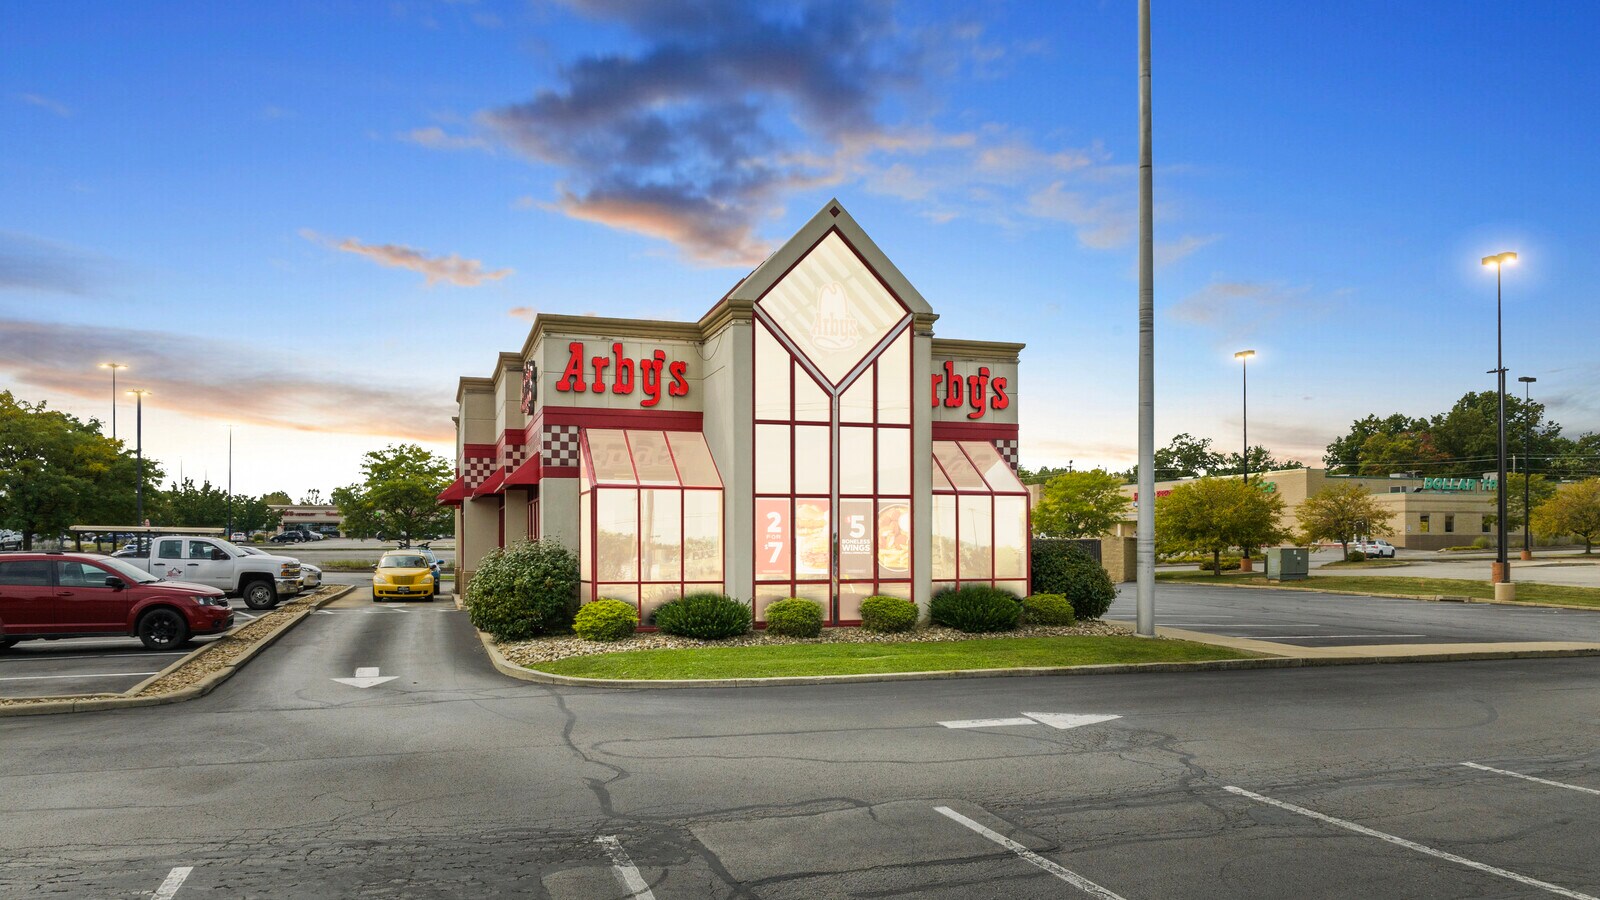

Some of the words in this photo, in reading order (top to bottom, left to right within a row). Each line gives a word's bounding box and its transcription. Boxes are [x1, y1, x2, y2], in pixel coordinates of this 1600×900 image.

[556, 341, 690, 407] Arby's
[1424, 477, 1476, 490] DOLLAR
[766, 512, 782, 532] 2
[764, 542, 783, 563] $7
